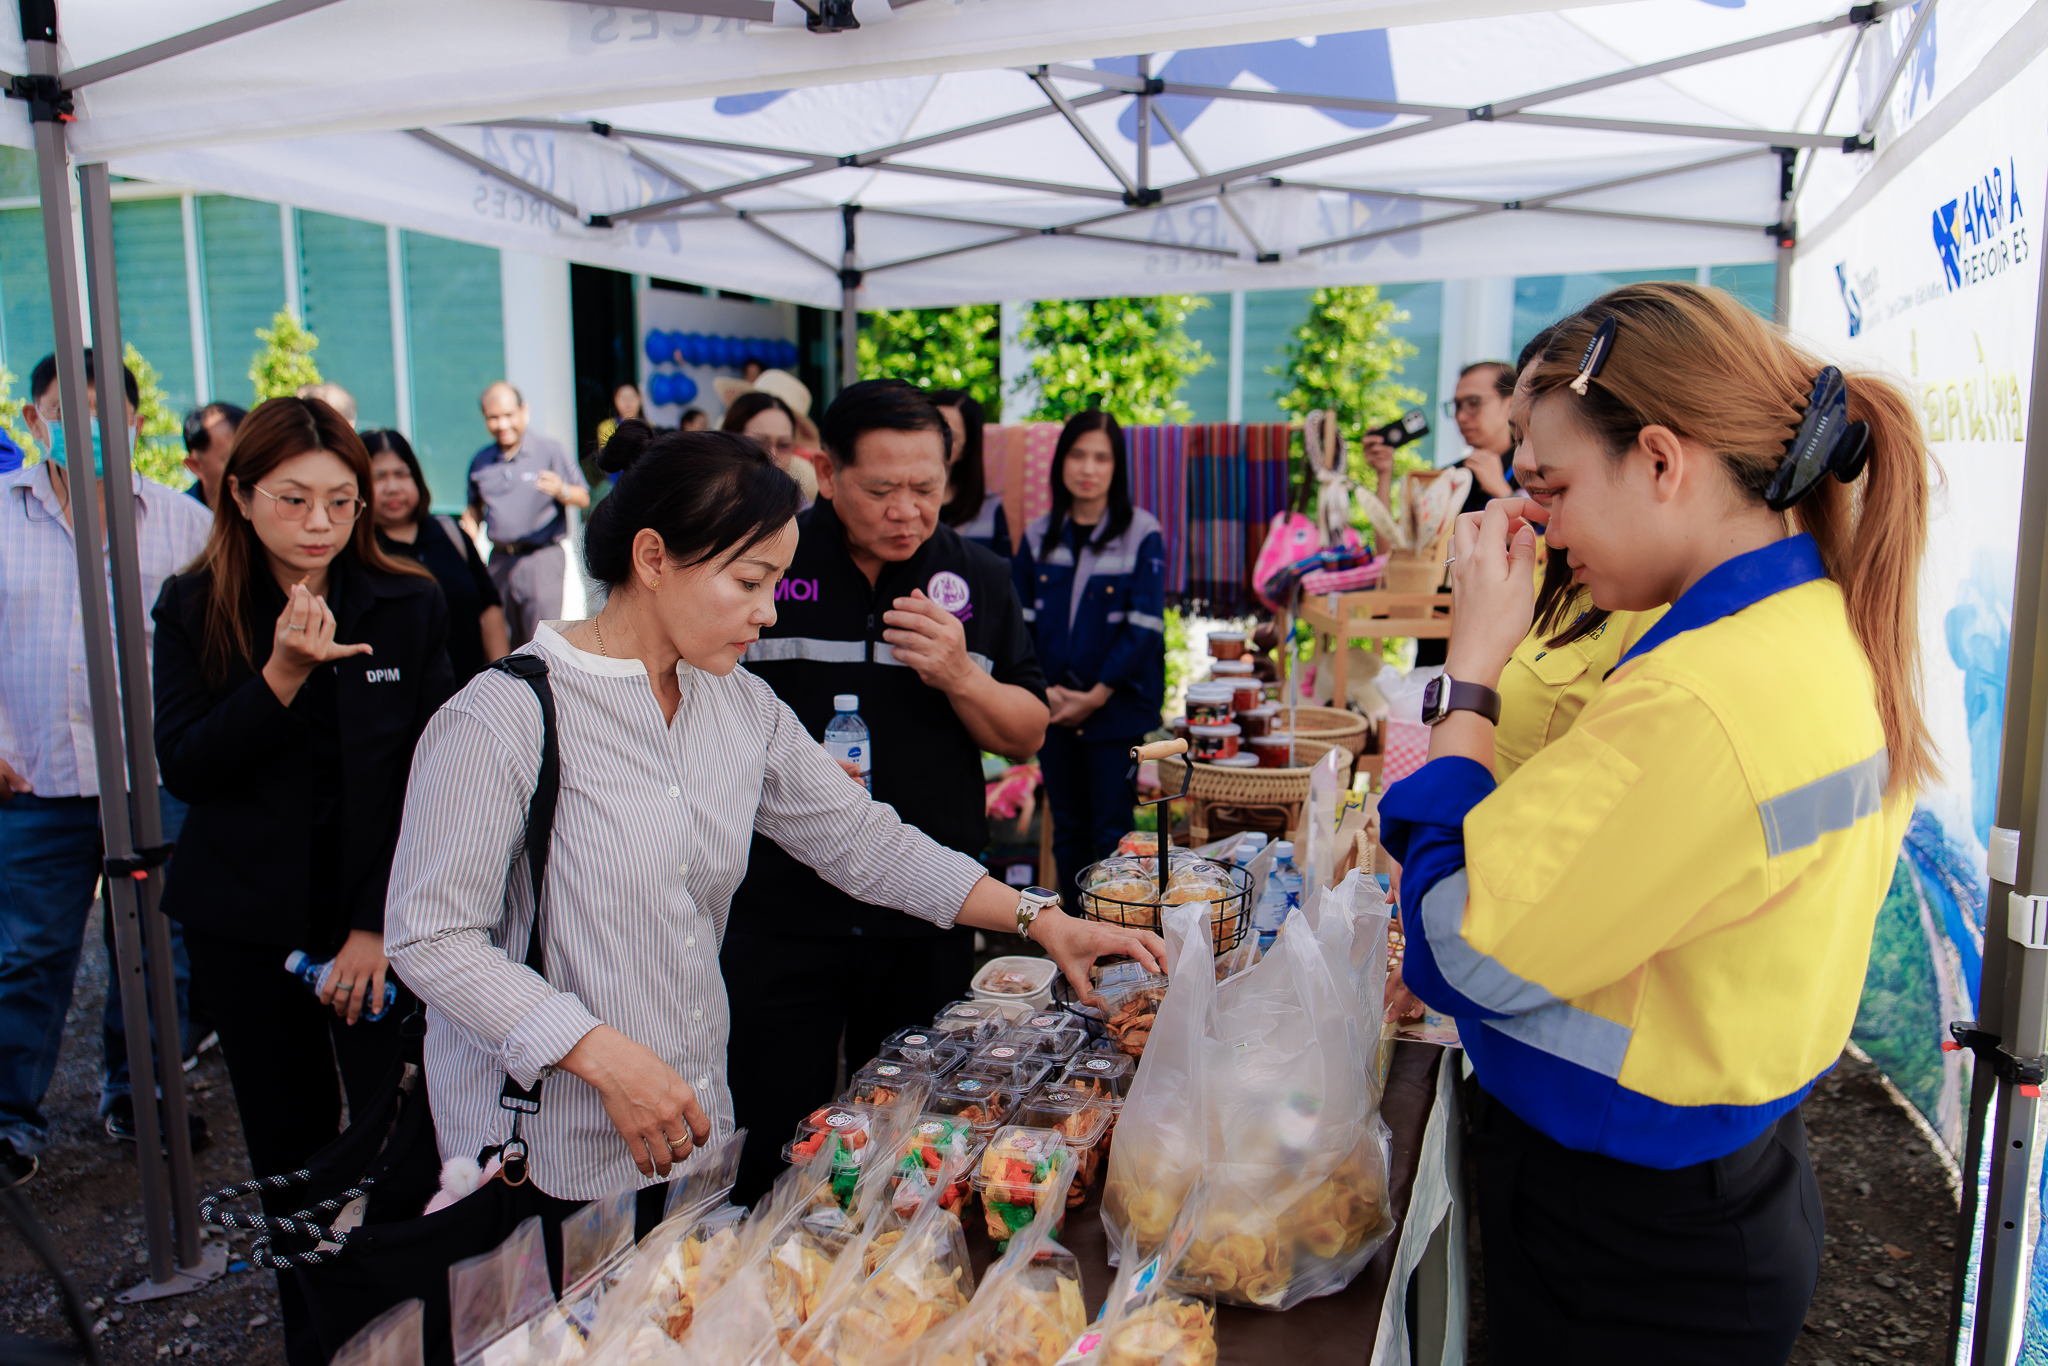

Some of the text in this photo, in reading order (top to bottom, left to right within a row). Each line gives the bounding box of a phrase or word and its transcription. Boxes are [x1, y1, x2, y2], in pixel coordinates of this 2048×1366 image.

[1962, 155, 2023, 247] AKARA
[774, 578, 818, 601] MOI
[366, 667, 401, 683] DPIM
